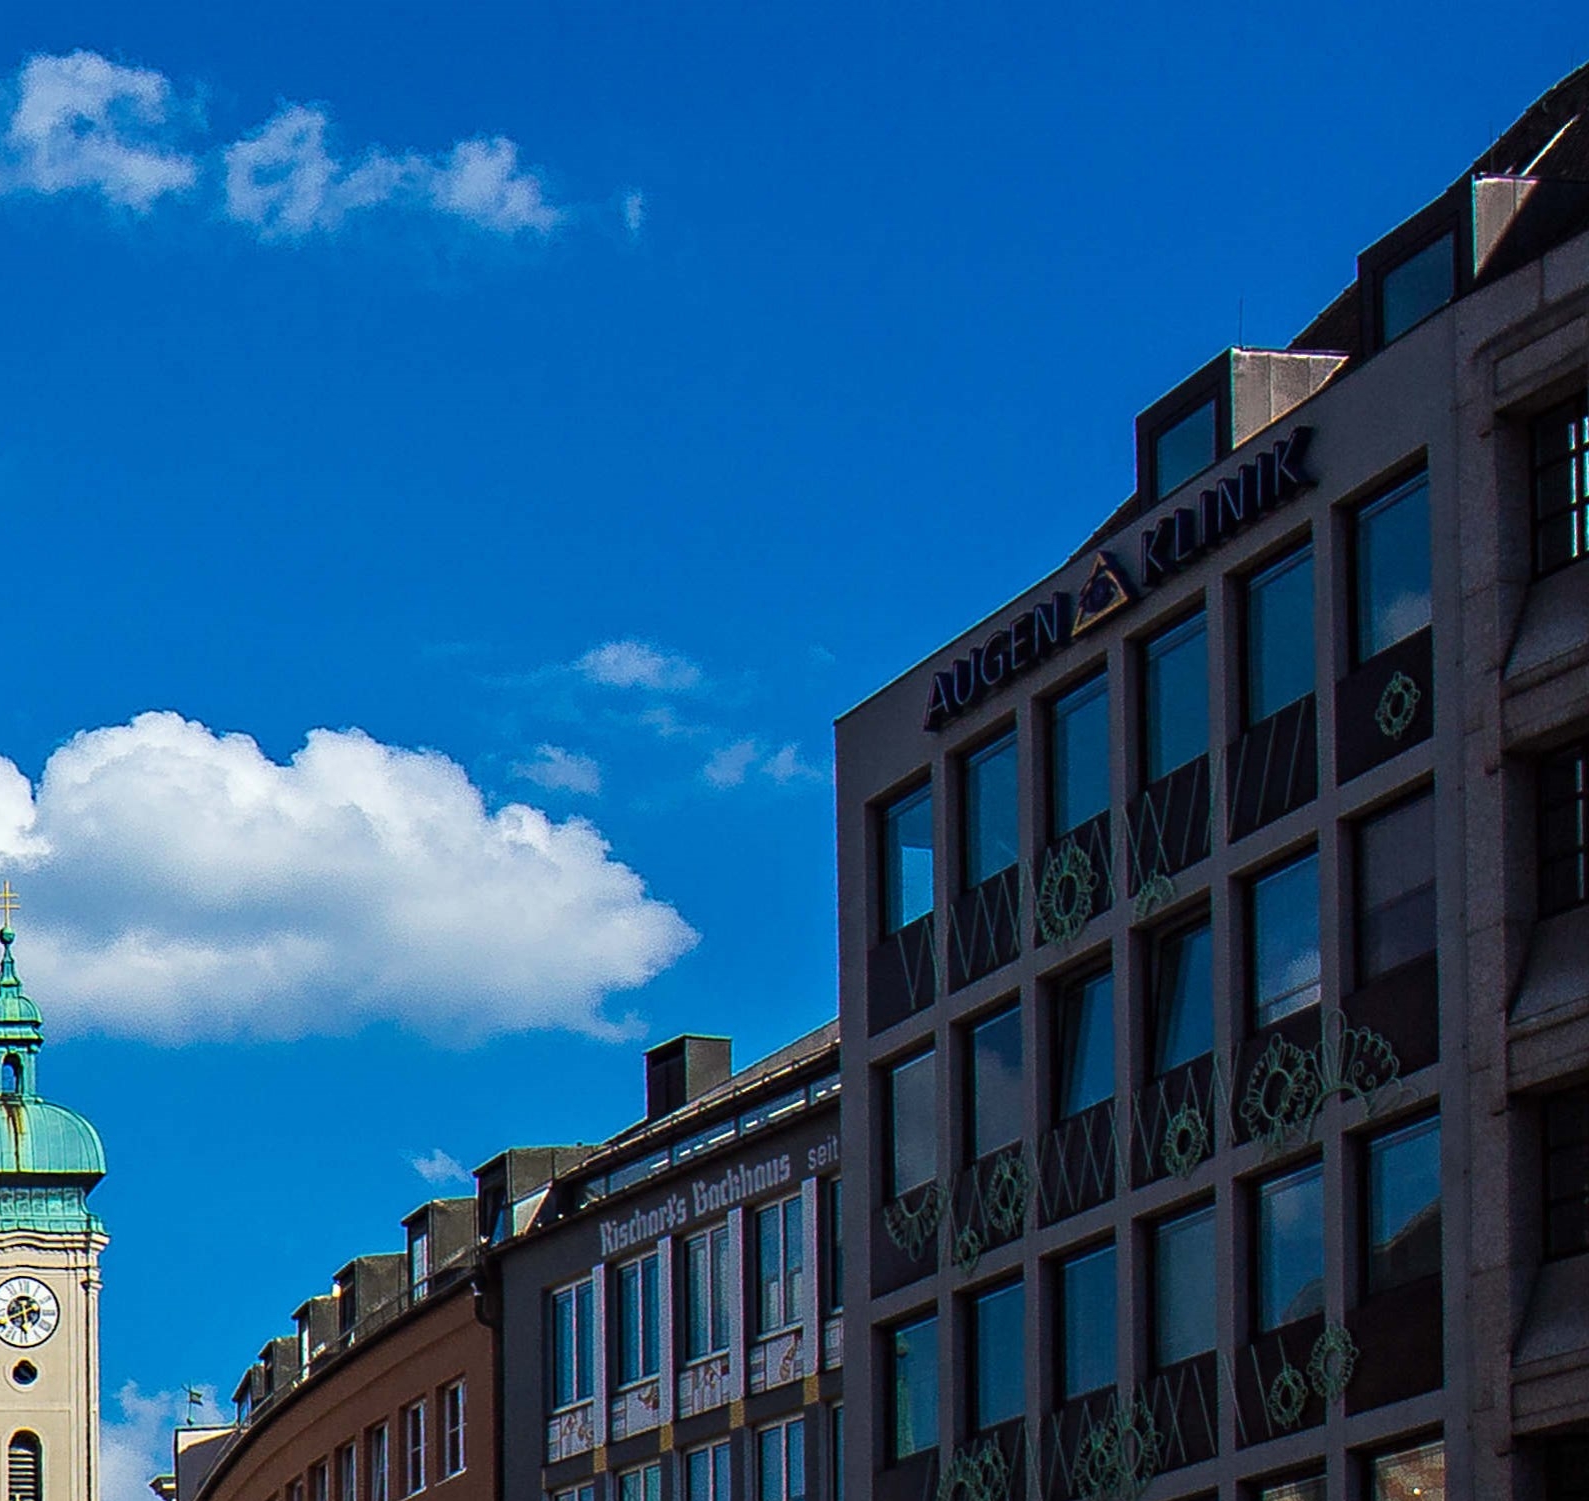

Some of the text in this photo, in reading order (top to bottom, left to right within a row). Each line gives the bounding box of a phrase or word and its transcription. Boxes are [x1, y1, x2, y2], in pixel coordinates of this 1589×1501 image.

[923, 425, 1319, 732] AUGEN KLINIK
[691, 1153, 791, 1217] Backhaus
[807, 1135, 839, 1171] seit
